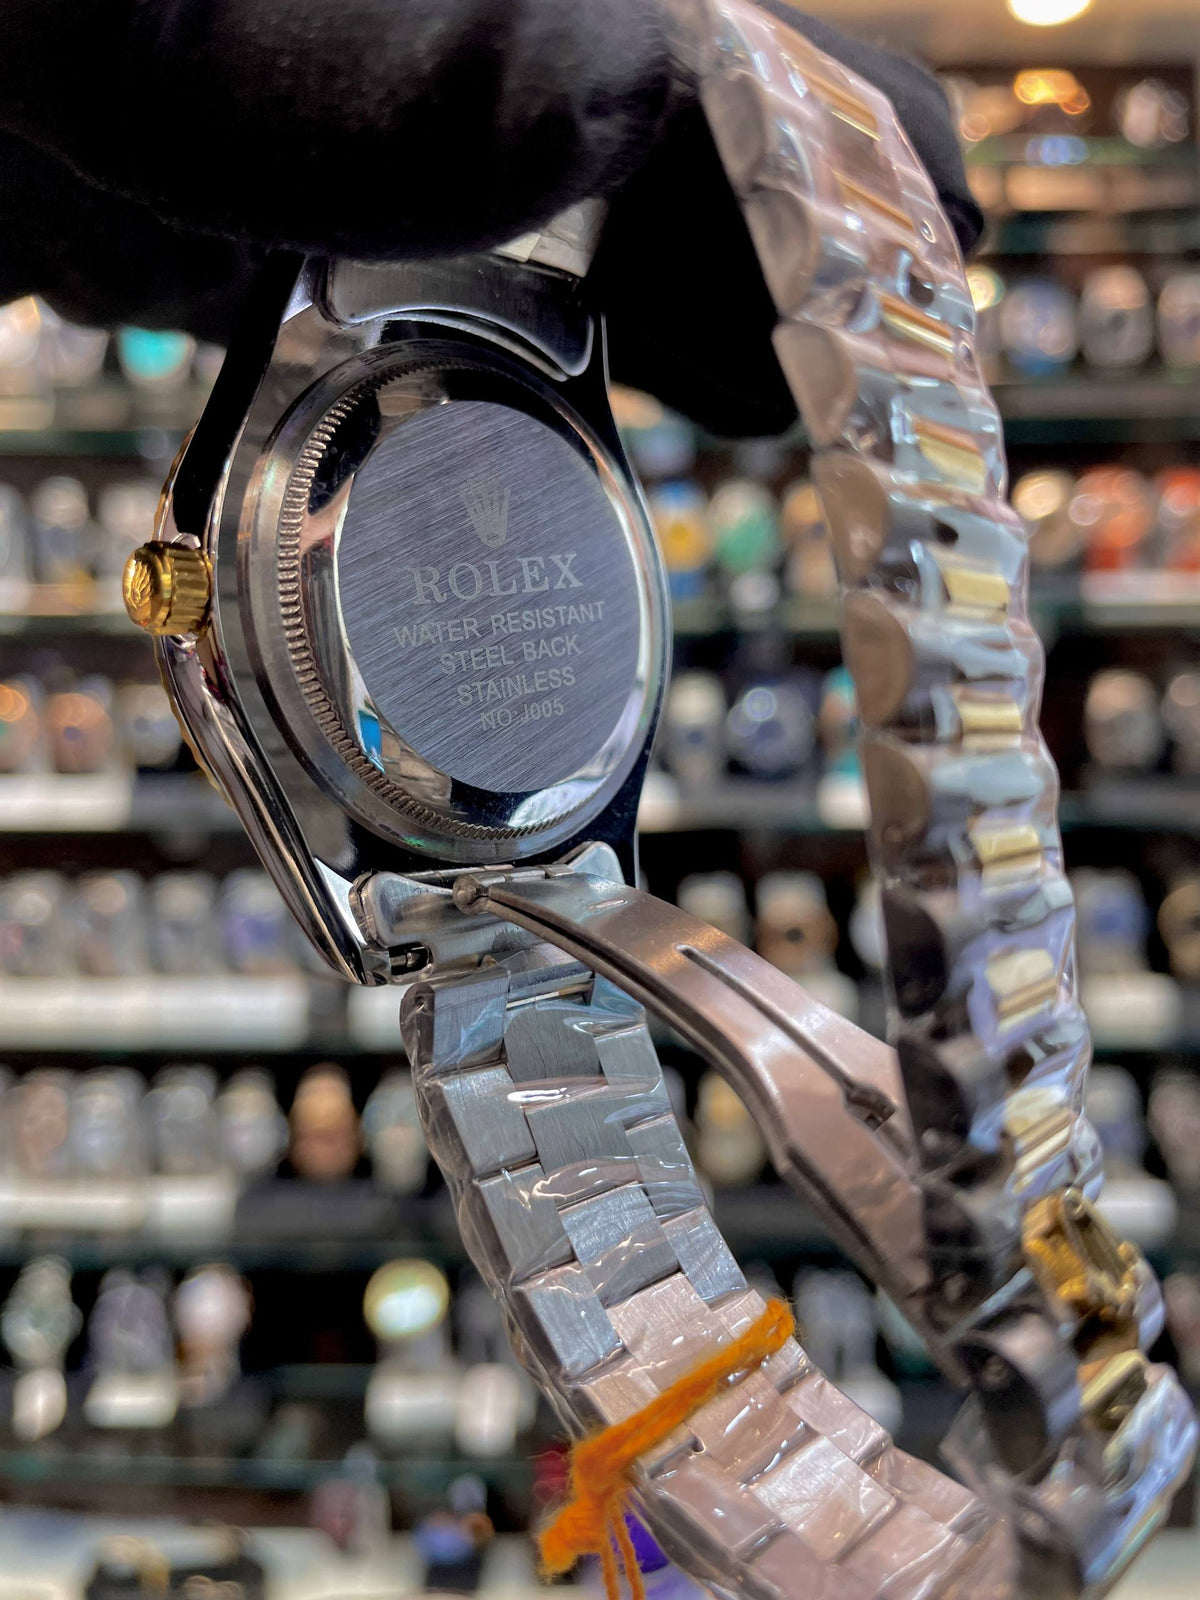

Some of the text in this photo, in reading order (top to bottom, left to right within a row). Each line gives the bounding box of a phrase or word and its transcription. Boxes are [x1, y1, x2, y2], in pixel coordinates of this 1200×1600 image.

[408, 553, 584, 605] ROLEX
[394, 601, 605, 648] WATER RESISTANT
[440, 634, 581, 674] STEEL BACK
[457, 666, 576, 706] STAINLESS
